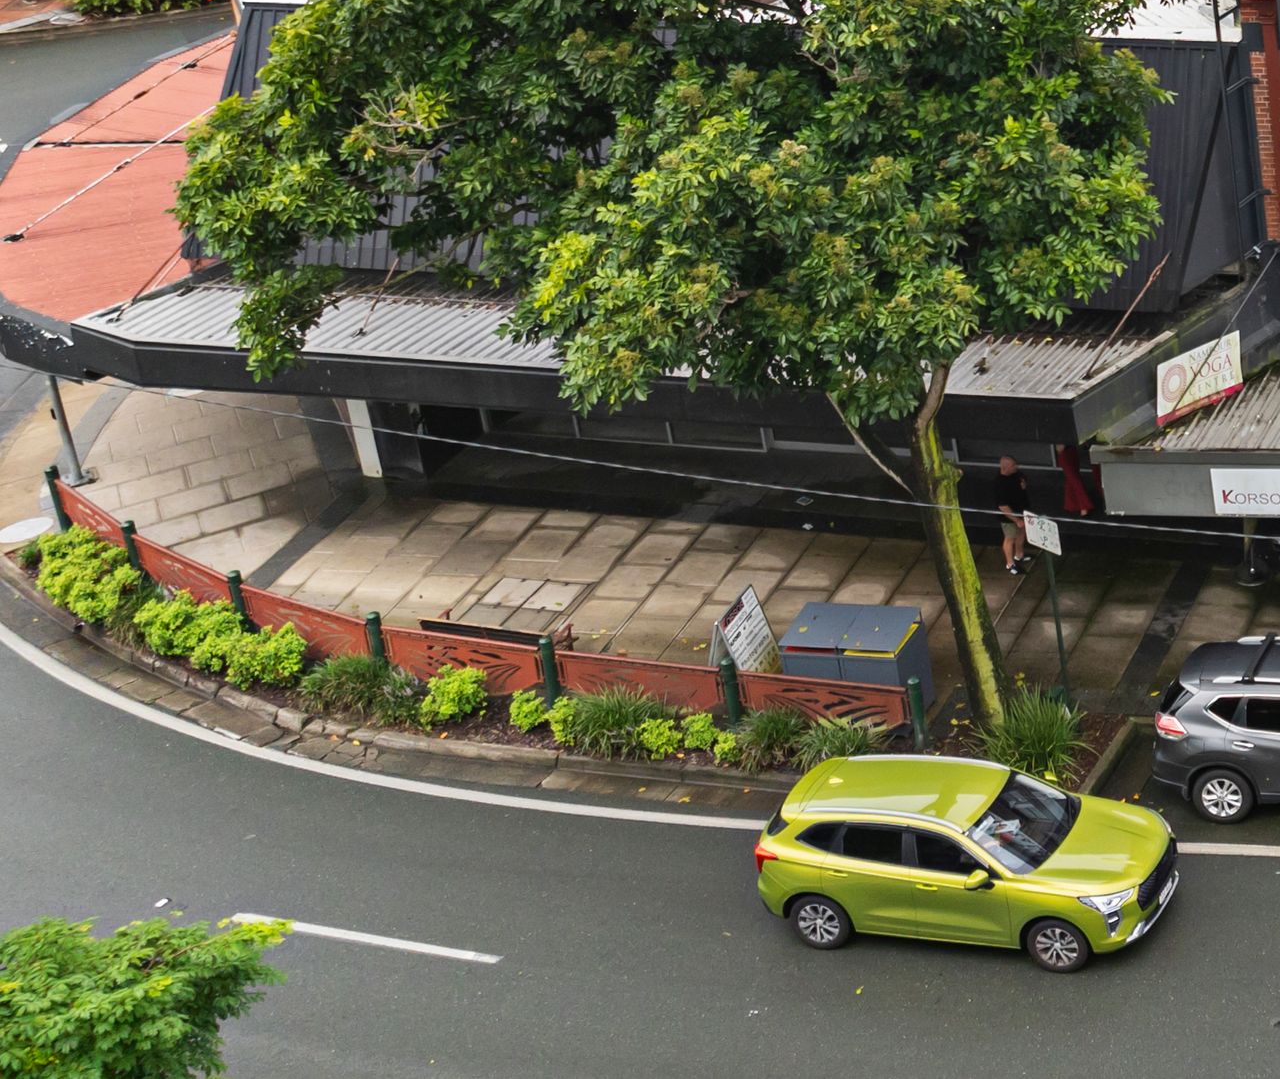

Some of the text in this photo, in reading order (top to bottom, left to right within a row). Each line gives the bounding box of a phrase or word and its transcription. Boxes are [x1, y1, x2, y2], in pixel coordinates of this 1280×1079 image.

[1188, 337, 1232, 363] NAMBUR
[1190, 353, 1232, 378] YOGA
[1188, 371, 1233, 396] CENTRE
